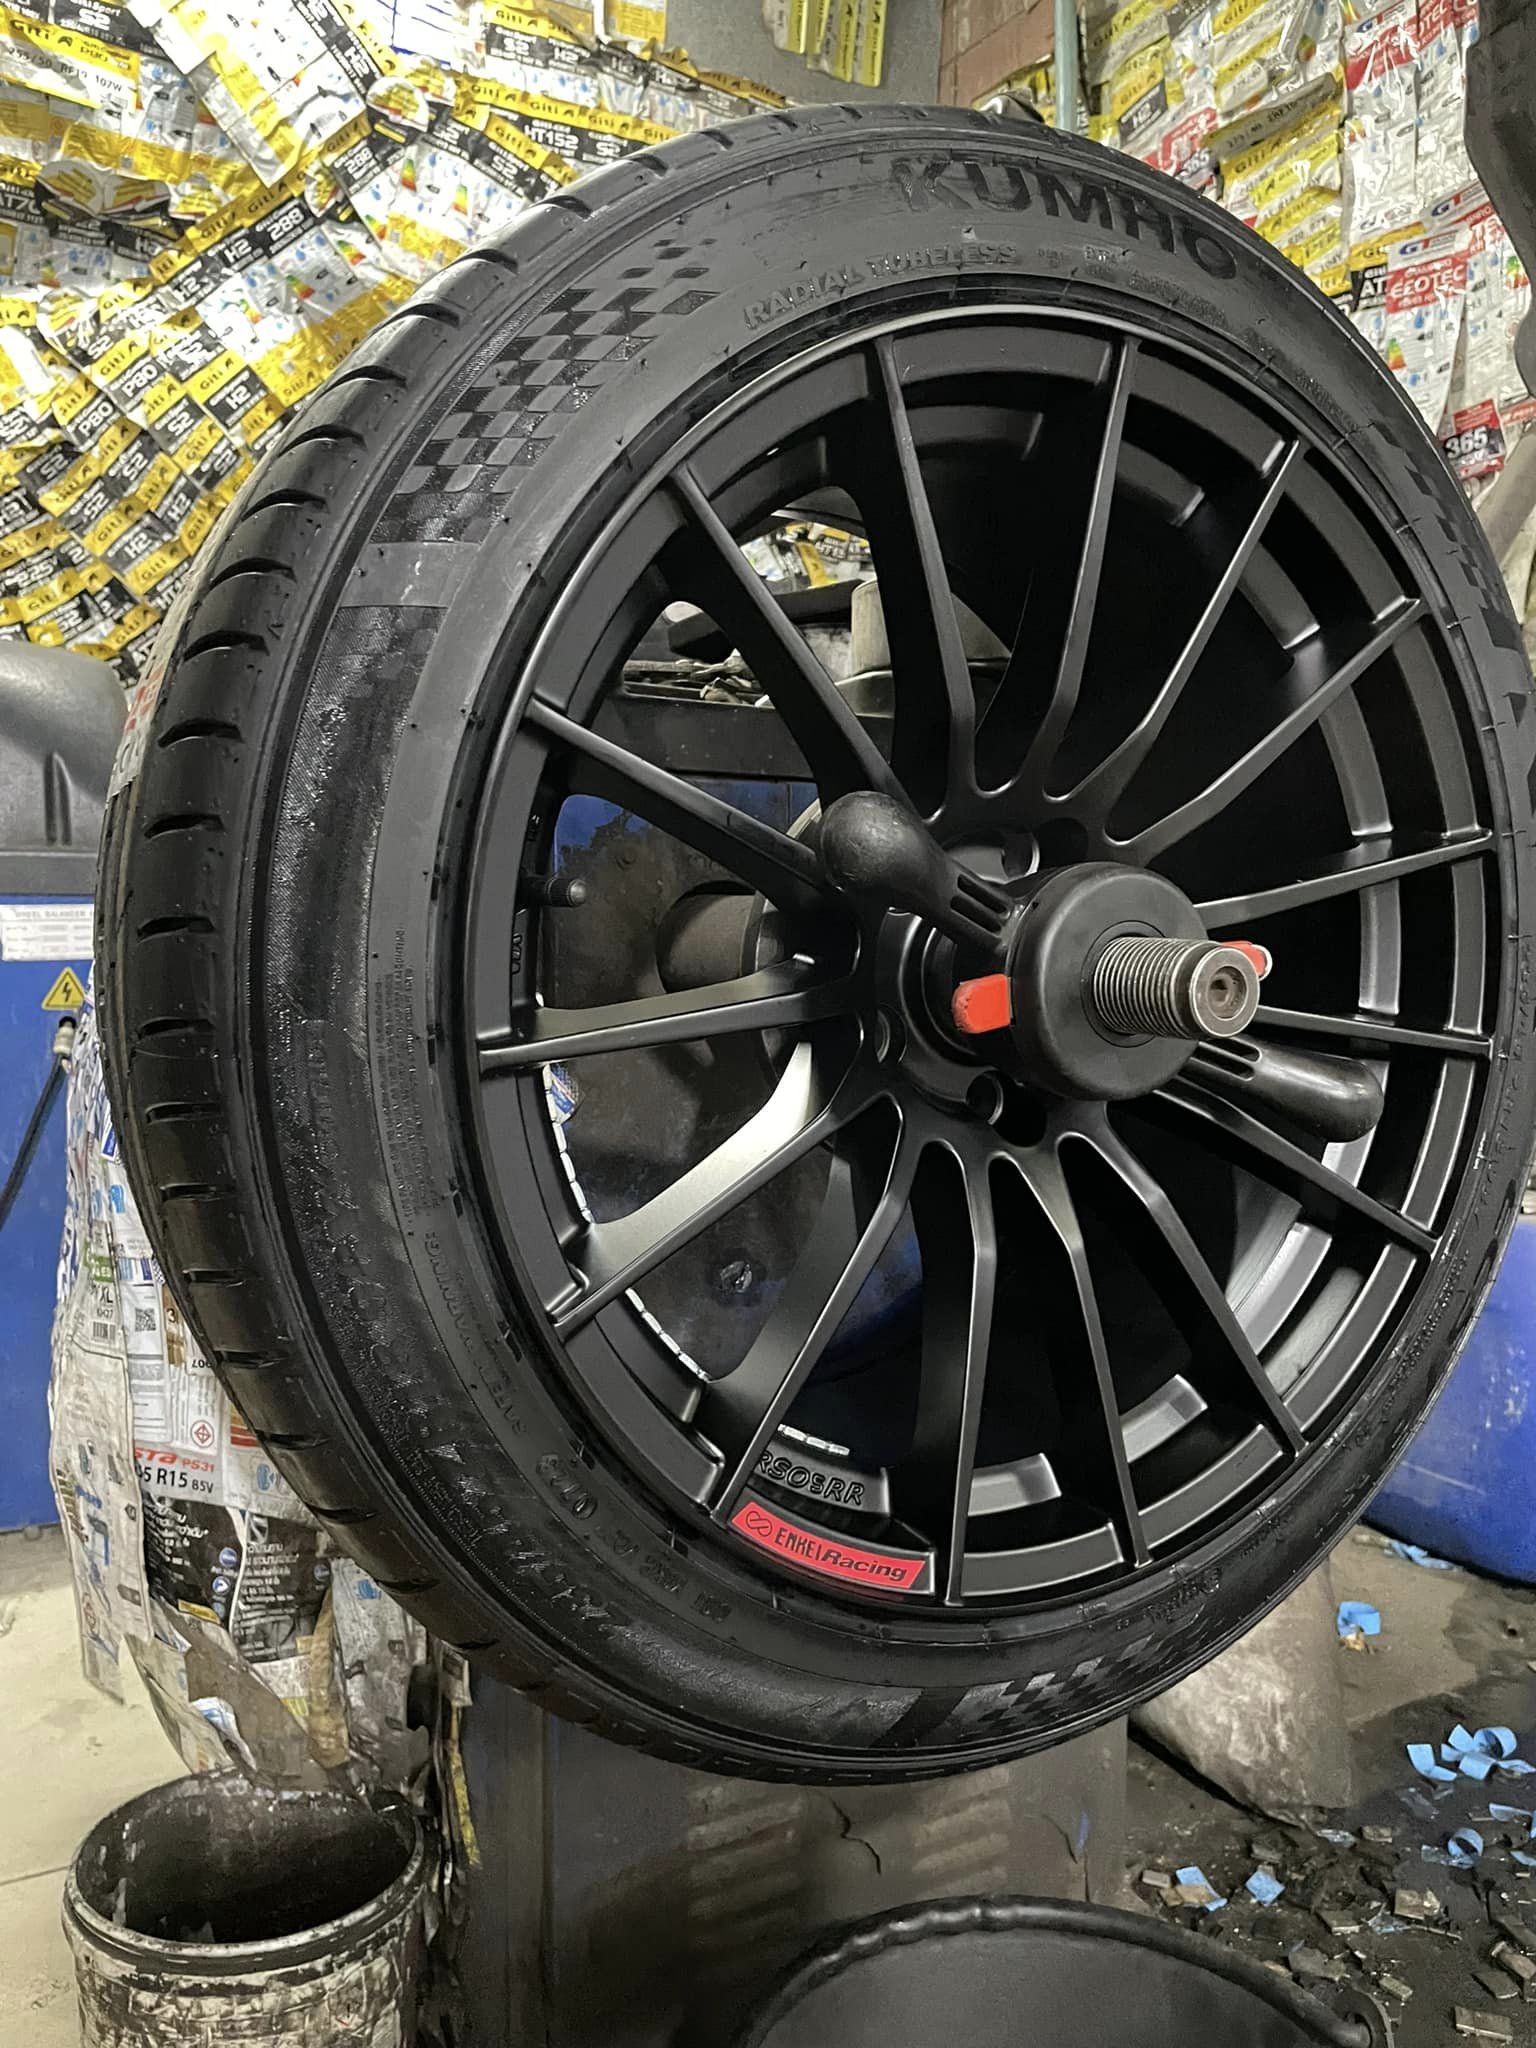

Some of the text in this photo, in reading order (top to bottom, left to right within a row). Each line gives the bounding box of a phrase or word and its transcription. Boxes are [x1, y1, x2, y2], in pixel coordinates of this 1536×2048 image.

[10, 19, 49, 39] Giti
[496, 10, 522, 24] Giti
[503, 38, 530, 57] S2
[471, 84, 499, 98] Giti
[530, 101, 558, 115] Giti
[588, 113, 615, 128] Giti
[495, 126, 523, 152] Giti
[524, 124, 579, 151] HT152
[492, 155, 518, 180] S2
[1234, 152, 1266, 175] Giti
[247, 192, 275, 214] Giti
[201, 220, 228, 239] Giti
[266, 207, 305, 241] 288
[891, 155, 1238, 281] KUMHO
[223, 238, 252, 264] H2
[743, 263, 864, 330] RADIAL
[88, 335, 115, 360] S2
[100, 353, 126, 376] Giti
[121, 363, 158, 398] P80
[199, 370, 224, 391] Giti
[225, 385, 251, 411] H2
[79, 401, 115, 438] P80
[168, 411, 195, 437] S2
[186, 435, 208, 460] Giti
[1445, 425, 1489, 459] 365
[40, 452, 69, 480] S2
[122, 452, 149, 481] S2
[213, 447, 238, 476] S2
[83, 491, 110, 520] S2
[167, 492, 192, 521] H2
[97, 517, 122, 542] Giti
[124, 531, 152, 559] H2
[142, 558, 167, 581] Giti
[181, 1458, 215, 1473] PS31
[156, 1468, 188, 1488] R15
[191, 1479, 215, 1494] 85V
[774, 1527, 908, 1582] ENKEI Racing
